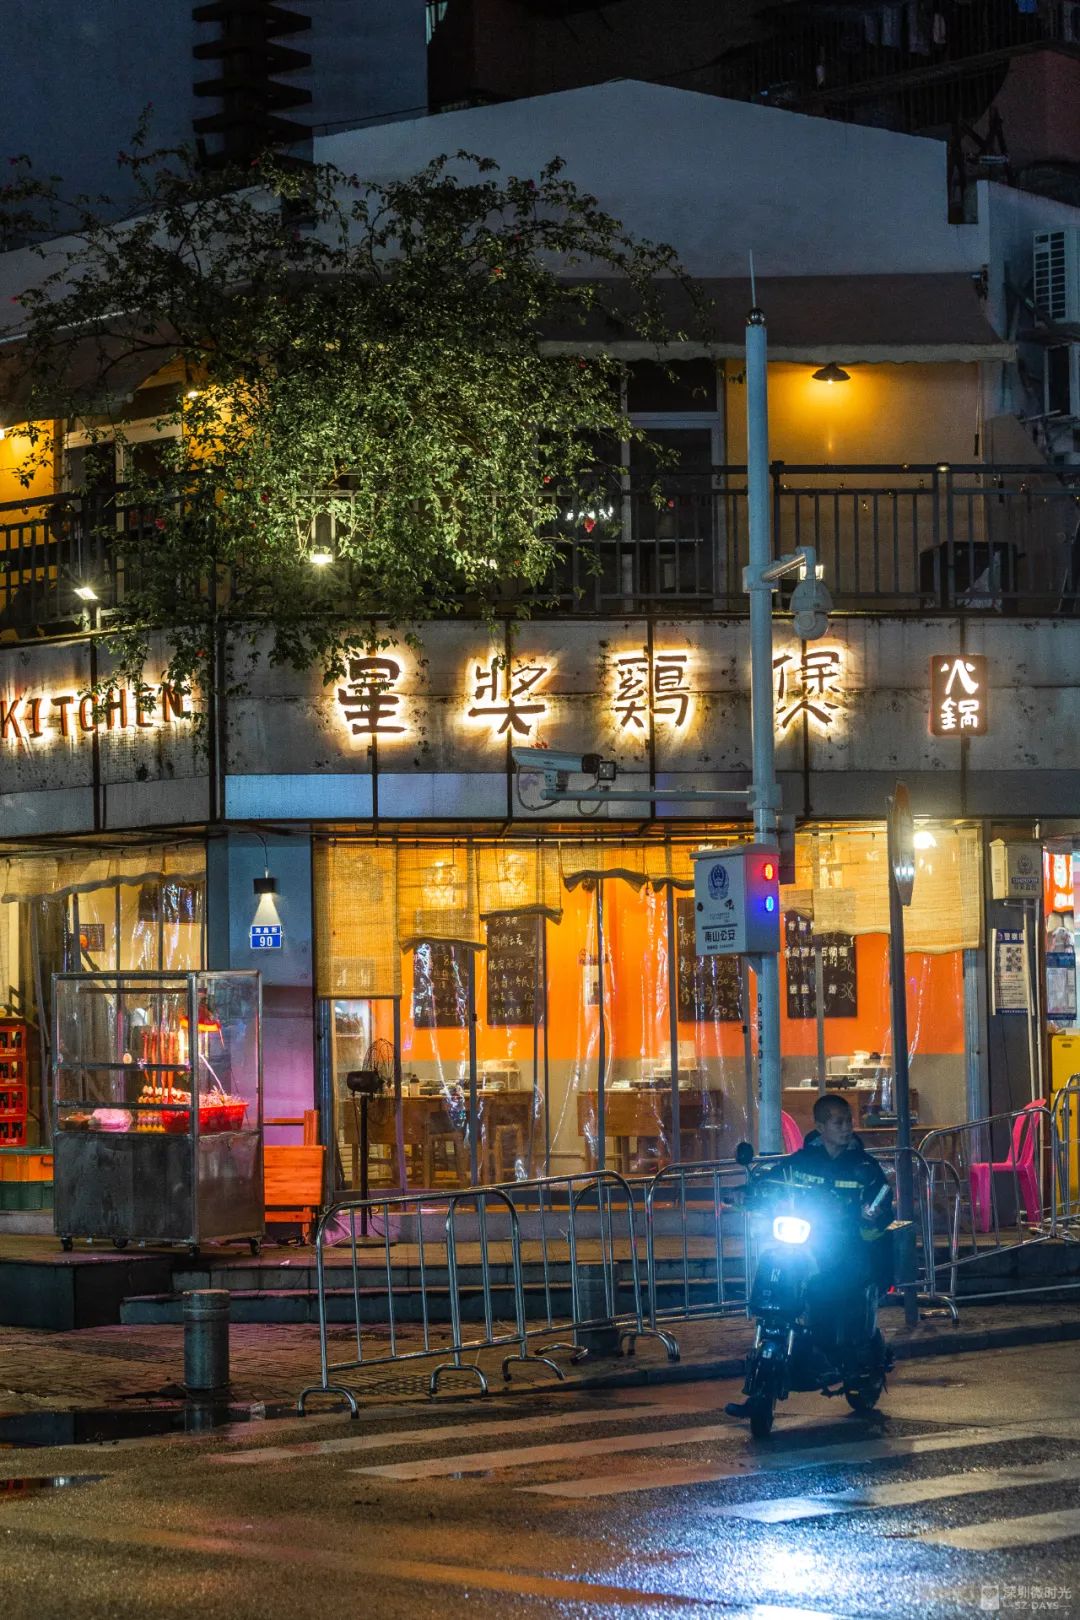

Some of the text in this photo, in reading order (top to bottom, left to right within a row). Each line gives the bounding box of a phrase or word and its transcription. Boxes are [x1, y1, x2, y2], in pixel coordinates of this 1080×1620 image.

[0, 681, 185, 739] KITCHEN
[260, 936, 273, 947] 90
[705, 929, 736, 943] 南山公安
